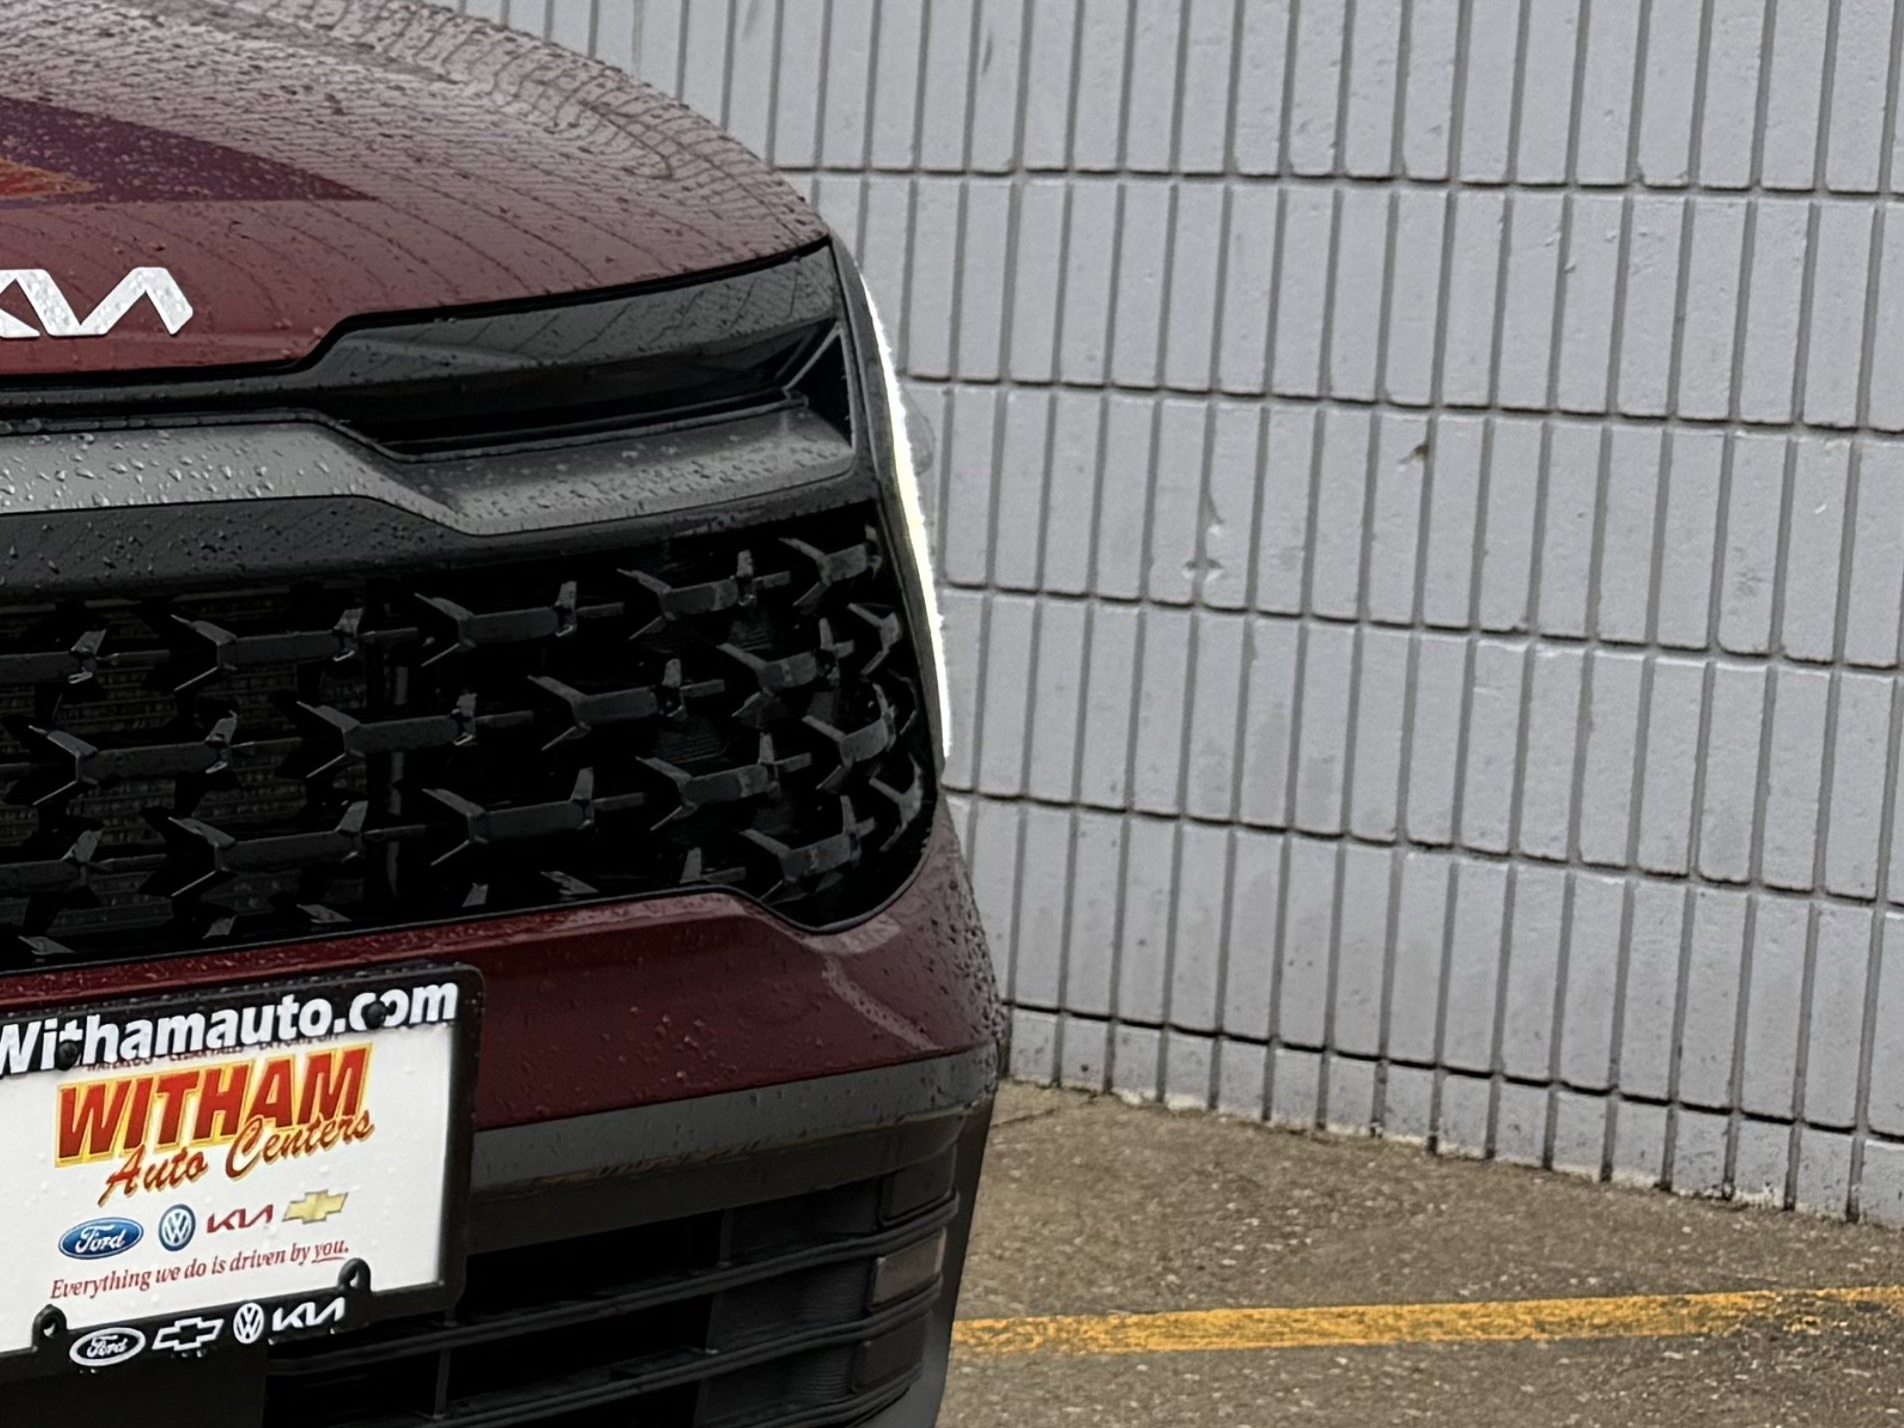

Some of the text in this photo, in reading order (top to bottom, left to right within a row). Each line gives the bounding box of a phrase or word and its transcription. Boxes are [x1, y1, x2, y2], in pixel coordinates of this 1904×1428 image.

[54, 1042, 373, 1168] WITHAM
[97, 1108, 375, 1208] Auto Centers
[75, 1224, 126, 1254] Ford
[206, 1203, 275, 1234] KIA
[50, 1239, 350, 1299] Everything we do is driven by you.
[272, 1297, 346, 1332] KIA
